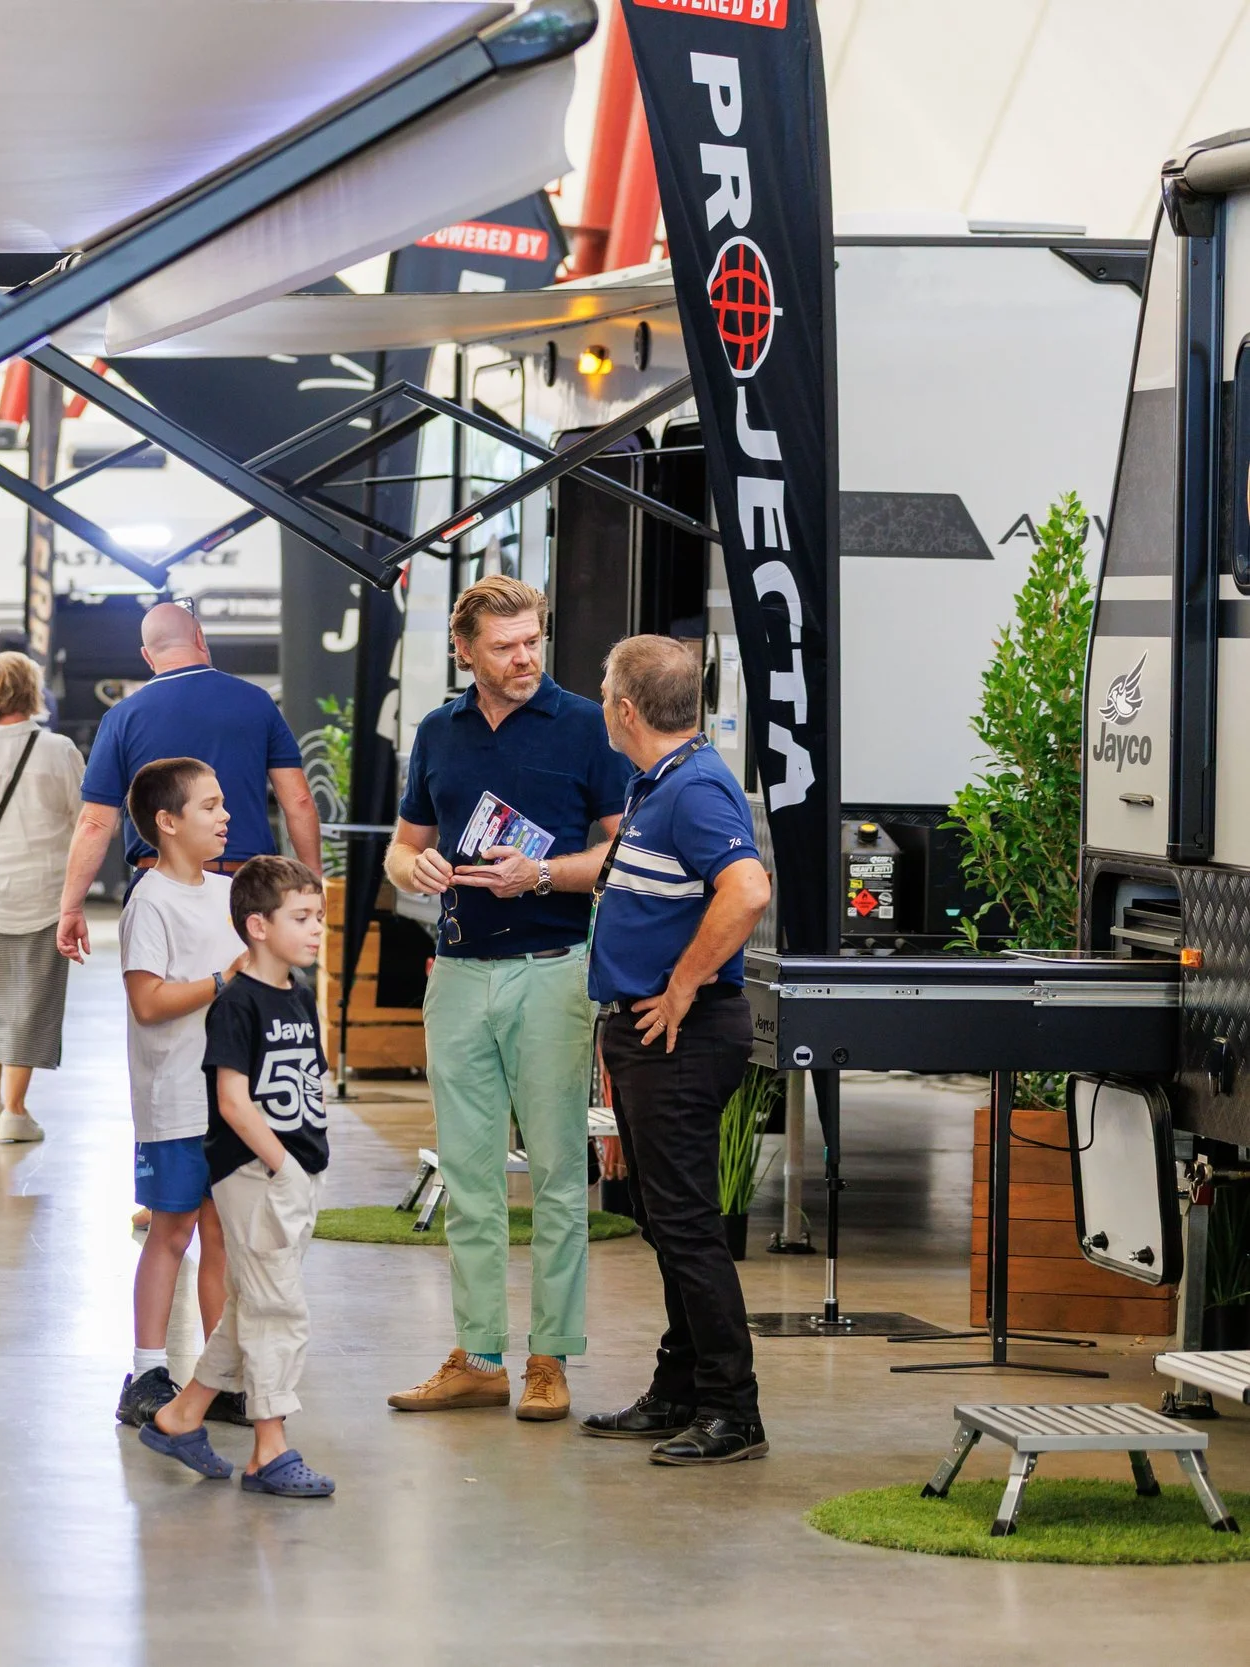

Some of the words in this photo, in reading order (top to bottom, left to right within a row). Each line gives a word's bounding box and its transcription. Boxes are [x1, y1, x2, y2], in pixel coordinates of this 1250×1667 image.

[751, 0, 778, 21] BY
[515, 232, 542, 256] BY
[1092, 721, 1152, 773] Jayco
[265, 1018, 315, 1044] Jayc
